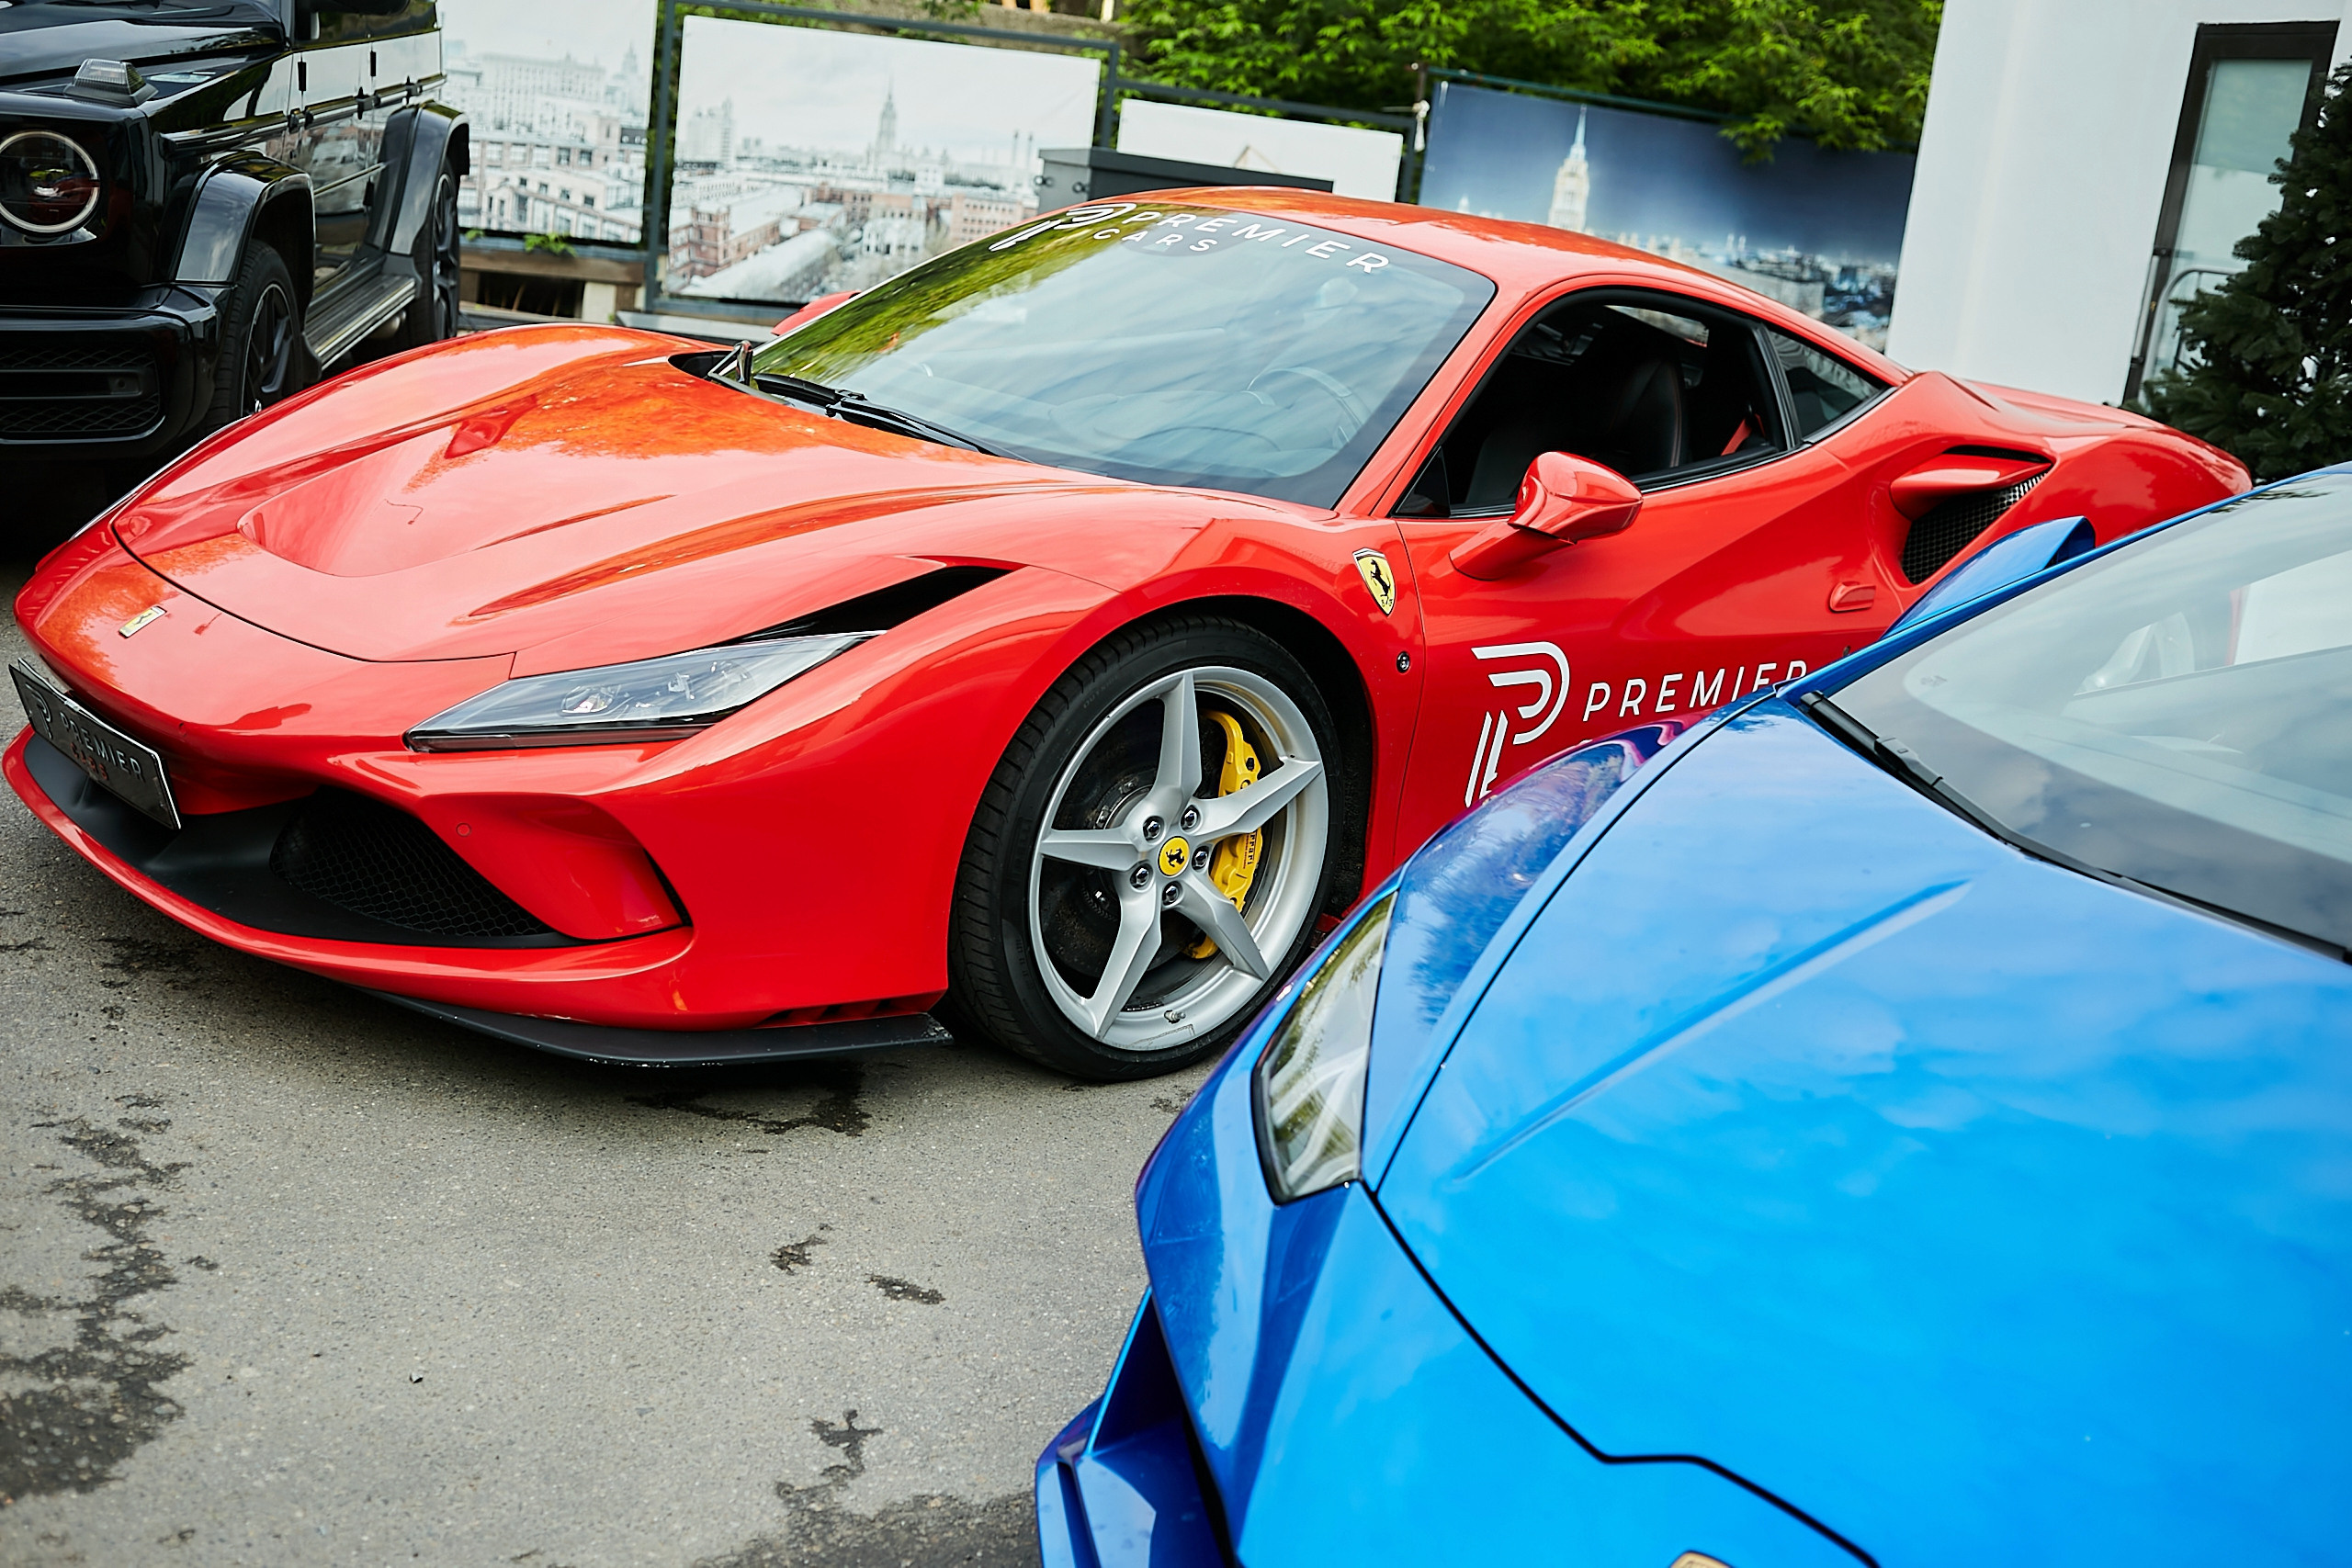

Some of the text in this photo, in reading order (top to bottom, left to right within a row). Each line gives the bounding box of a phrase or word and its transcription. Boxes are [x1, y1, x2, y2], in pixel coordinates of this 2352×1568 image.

[1093, 228, 1218, 252] CARS
[1122, 211, 1389, 274] PREMIER
[60, 712, 146, 783] PREMIER
